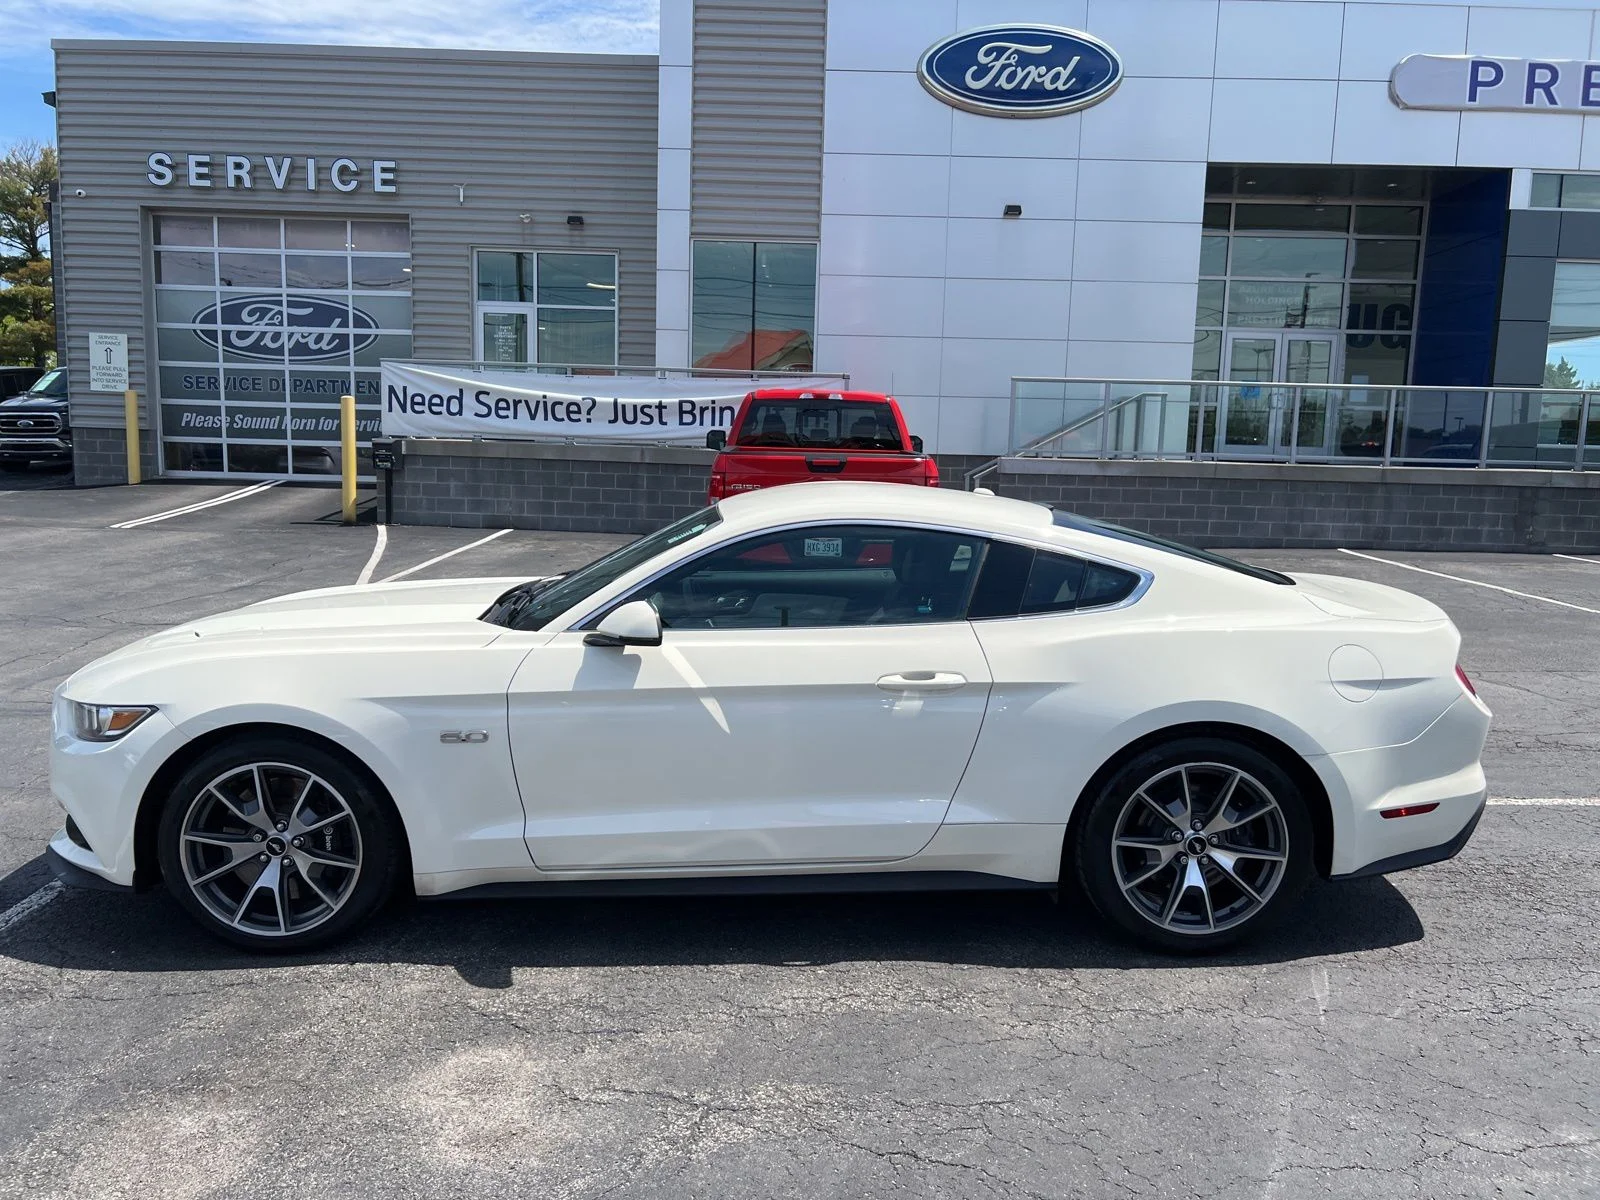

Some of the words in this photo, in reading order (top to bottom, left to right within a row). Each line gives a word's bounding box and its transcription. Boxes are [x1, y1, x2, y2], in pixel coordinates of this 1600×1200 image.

[964, 42, 1081, 91] Ford
[1467, 60, 1600, 107] PRE
[146, 151, 398, 193] SERVICE
[229, 303, 343, 351] Ford
[183, 374, 264, 393] SERVICE
[181, 412, 231, 428] Please
[233, 414, 280, 430] Sound
[318, 416, 340, 431] for
[355, 417, 382, 432] ervi
[388, 384, 464, 417] Need
[473, 389, 597, 424] Service?
[608, 398, 668, 427] Just
[821, 542, 839, 553] 3934
